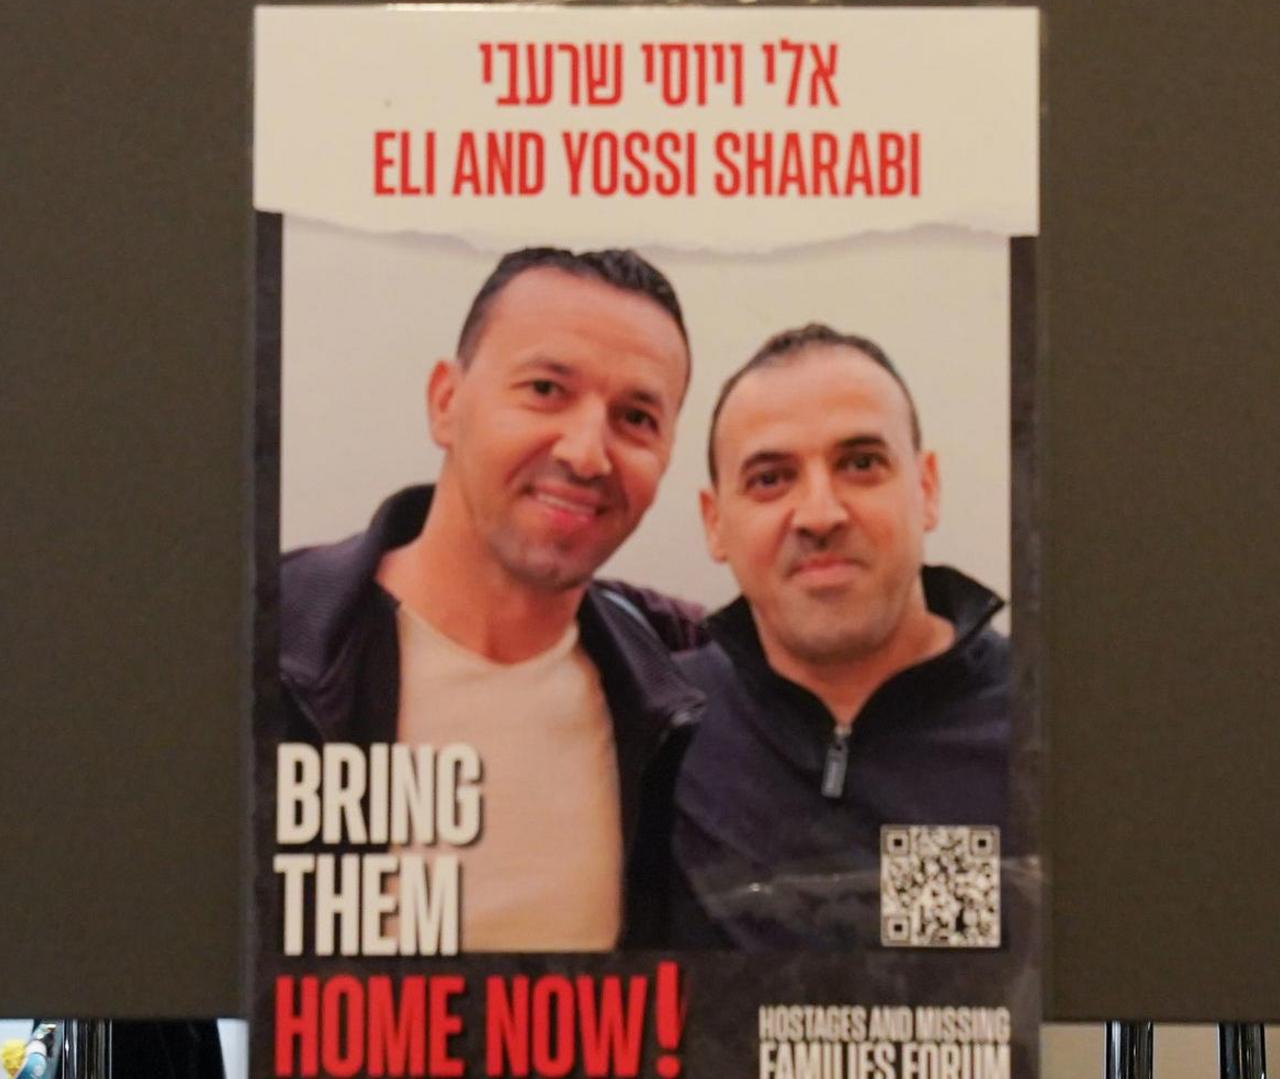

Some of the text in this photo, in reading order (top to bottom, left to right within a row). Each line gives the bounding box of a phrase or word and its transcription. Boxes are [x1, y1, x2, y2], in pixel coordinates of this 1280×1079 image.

[480, 39, 839, 106] אלי ויוסי שרעבי
[374, 132, 920, 196] ELI AND YOSSI SHARABI
[276, 742, 482, 845] BRING
[273, 853, 460, 956] THEM
[274, 961, 684, 1078] HOME NOW!
[758, 1005, 1010, 1043] HOSTAGES AND MISSING
